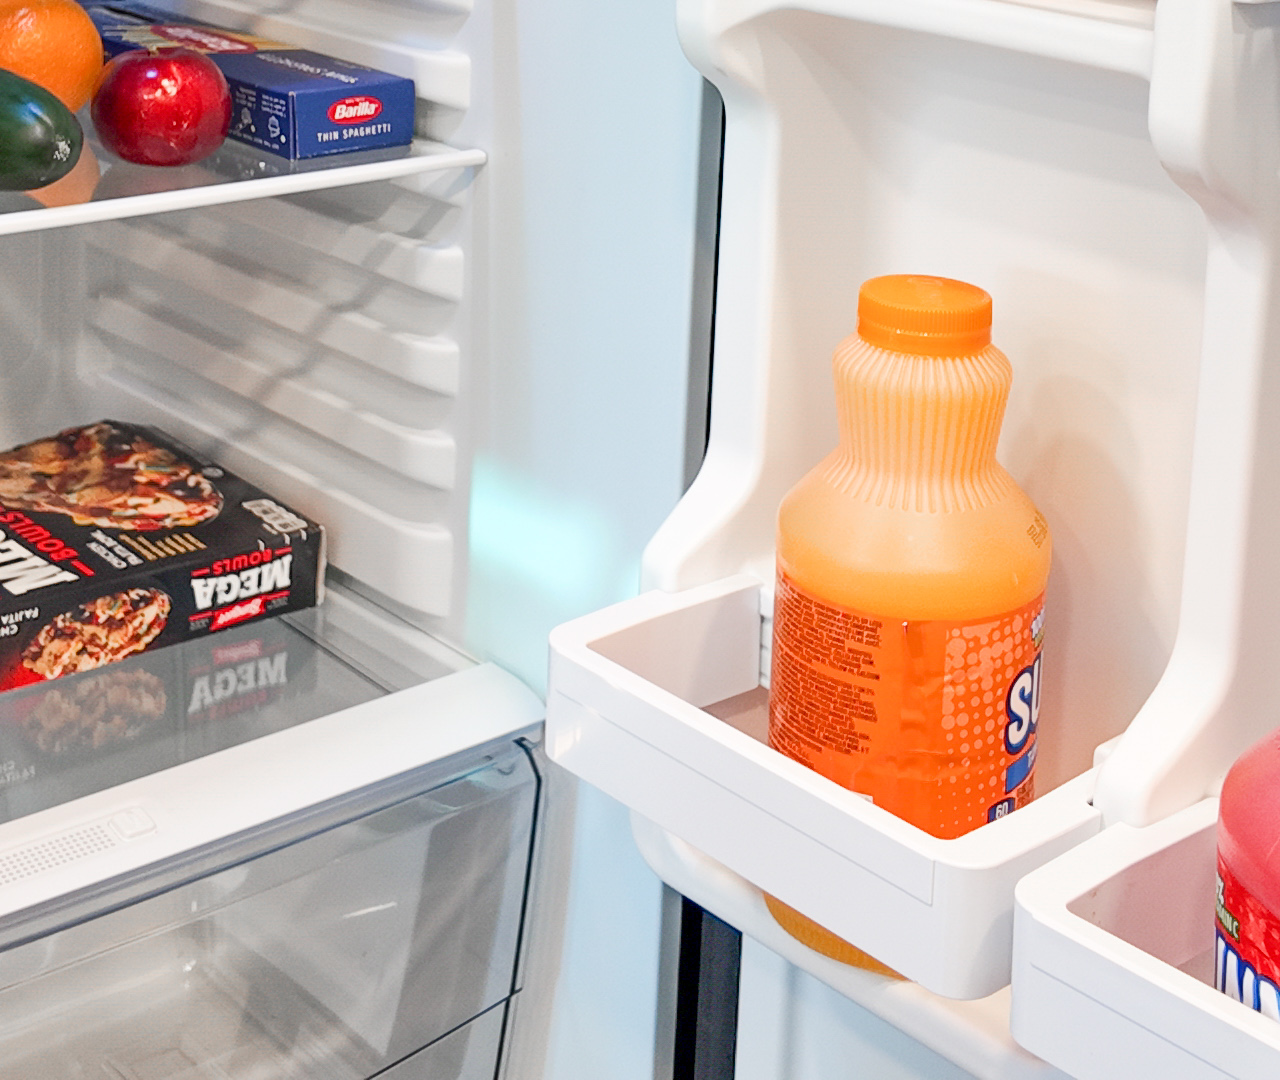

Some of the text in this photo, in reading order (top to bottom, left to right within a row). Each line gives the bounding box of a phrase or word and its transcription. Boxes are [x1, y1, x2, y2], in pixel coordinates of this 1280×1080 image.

[334, 101, 377, 120] Barilla
[317, 123, 391, 142] THIN SPAGHETTI
[211, 548, 274, 575] BOWLS
[190, 553, 293, 610] MEGA
[0, 606, 39, 625] FAJITA
[1008, 648, 1045, 746] SU
